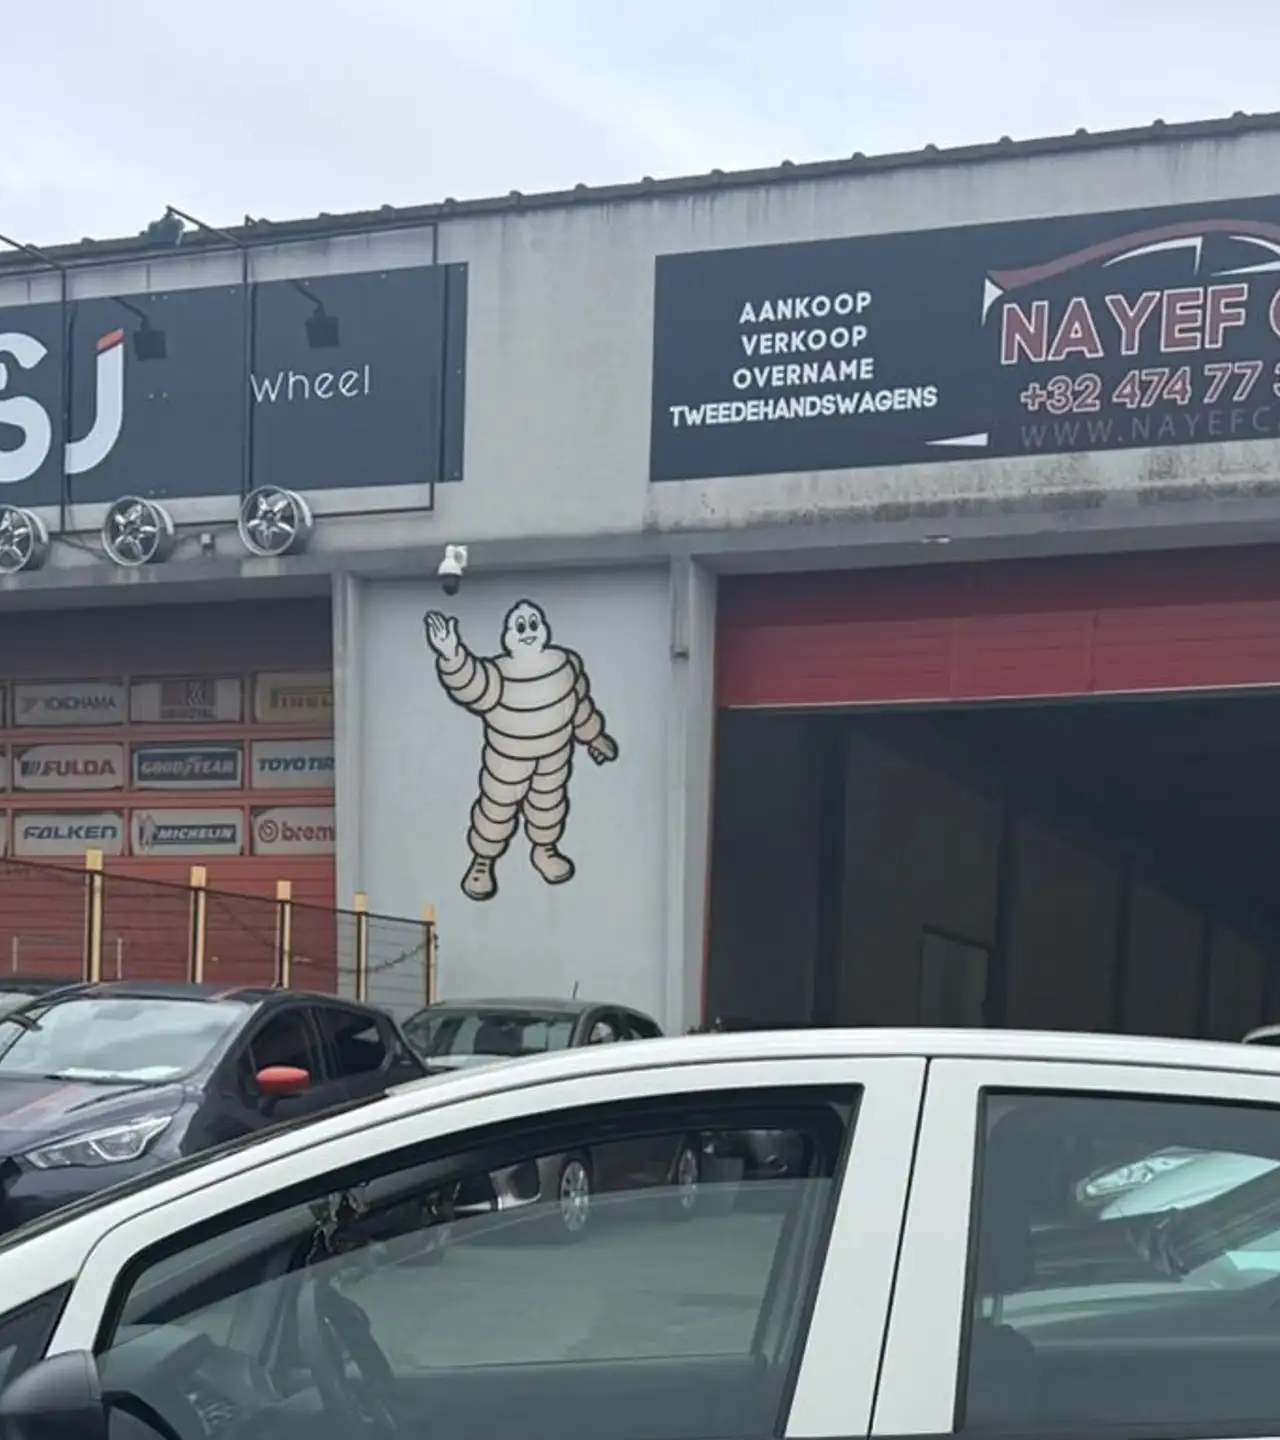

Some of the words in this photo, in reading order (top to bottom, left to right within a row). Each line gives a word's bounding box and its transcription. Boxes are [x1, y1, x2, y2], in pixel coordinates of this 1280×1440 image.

[739, 290, 872, 324] AANKOOP
[1000, 283, 1249, 365] NAYEF
[741, 325, 868, 356] VERKOOP
[732, 358, 874, 390] OVERNAME
[1021, 373, 1101, 414] +32
[1112, 366, 1192, 409] 474
[1203, 360, 1263, 403] 77
[669, 386, 939, 428] TWEEDEHANDSWAGENS
[40, 759, 117, 776] FULDA
[140, 757, 235, 777] GOODYEAR
[257, 757, 306, 773] TOYO
[23, 825, 117, 840] FALKEN
[157, 826, 235, 841] MICHELIN
